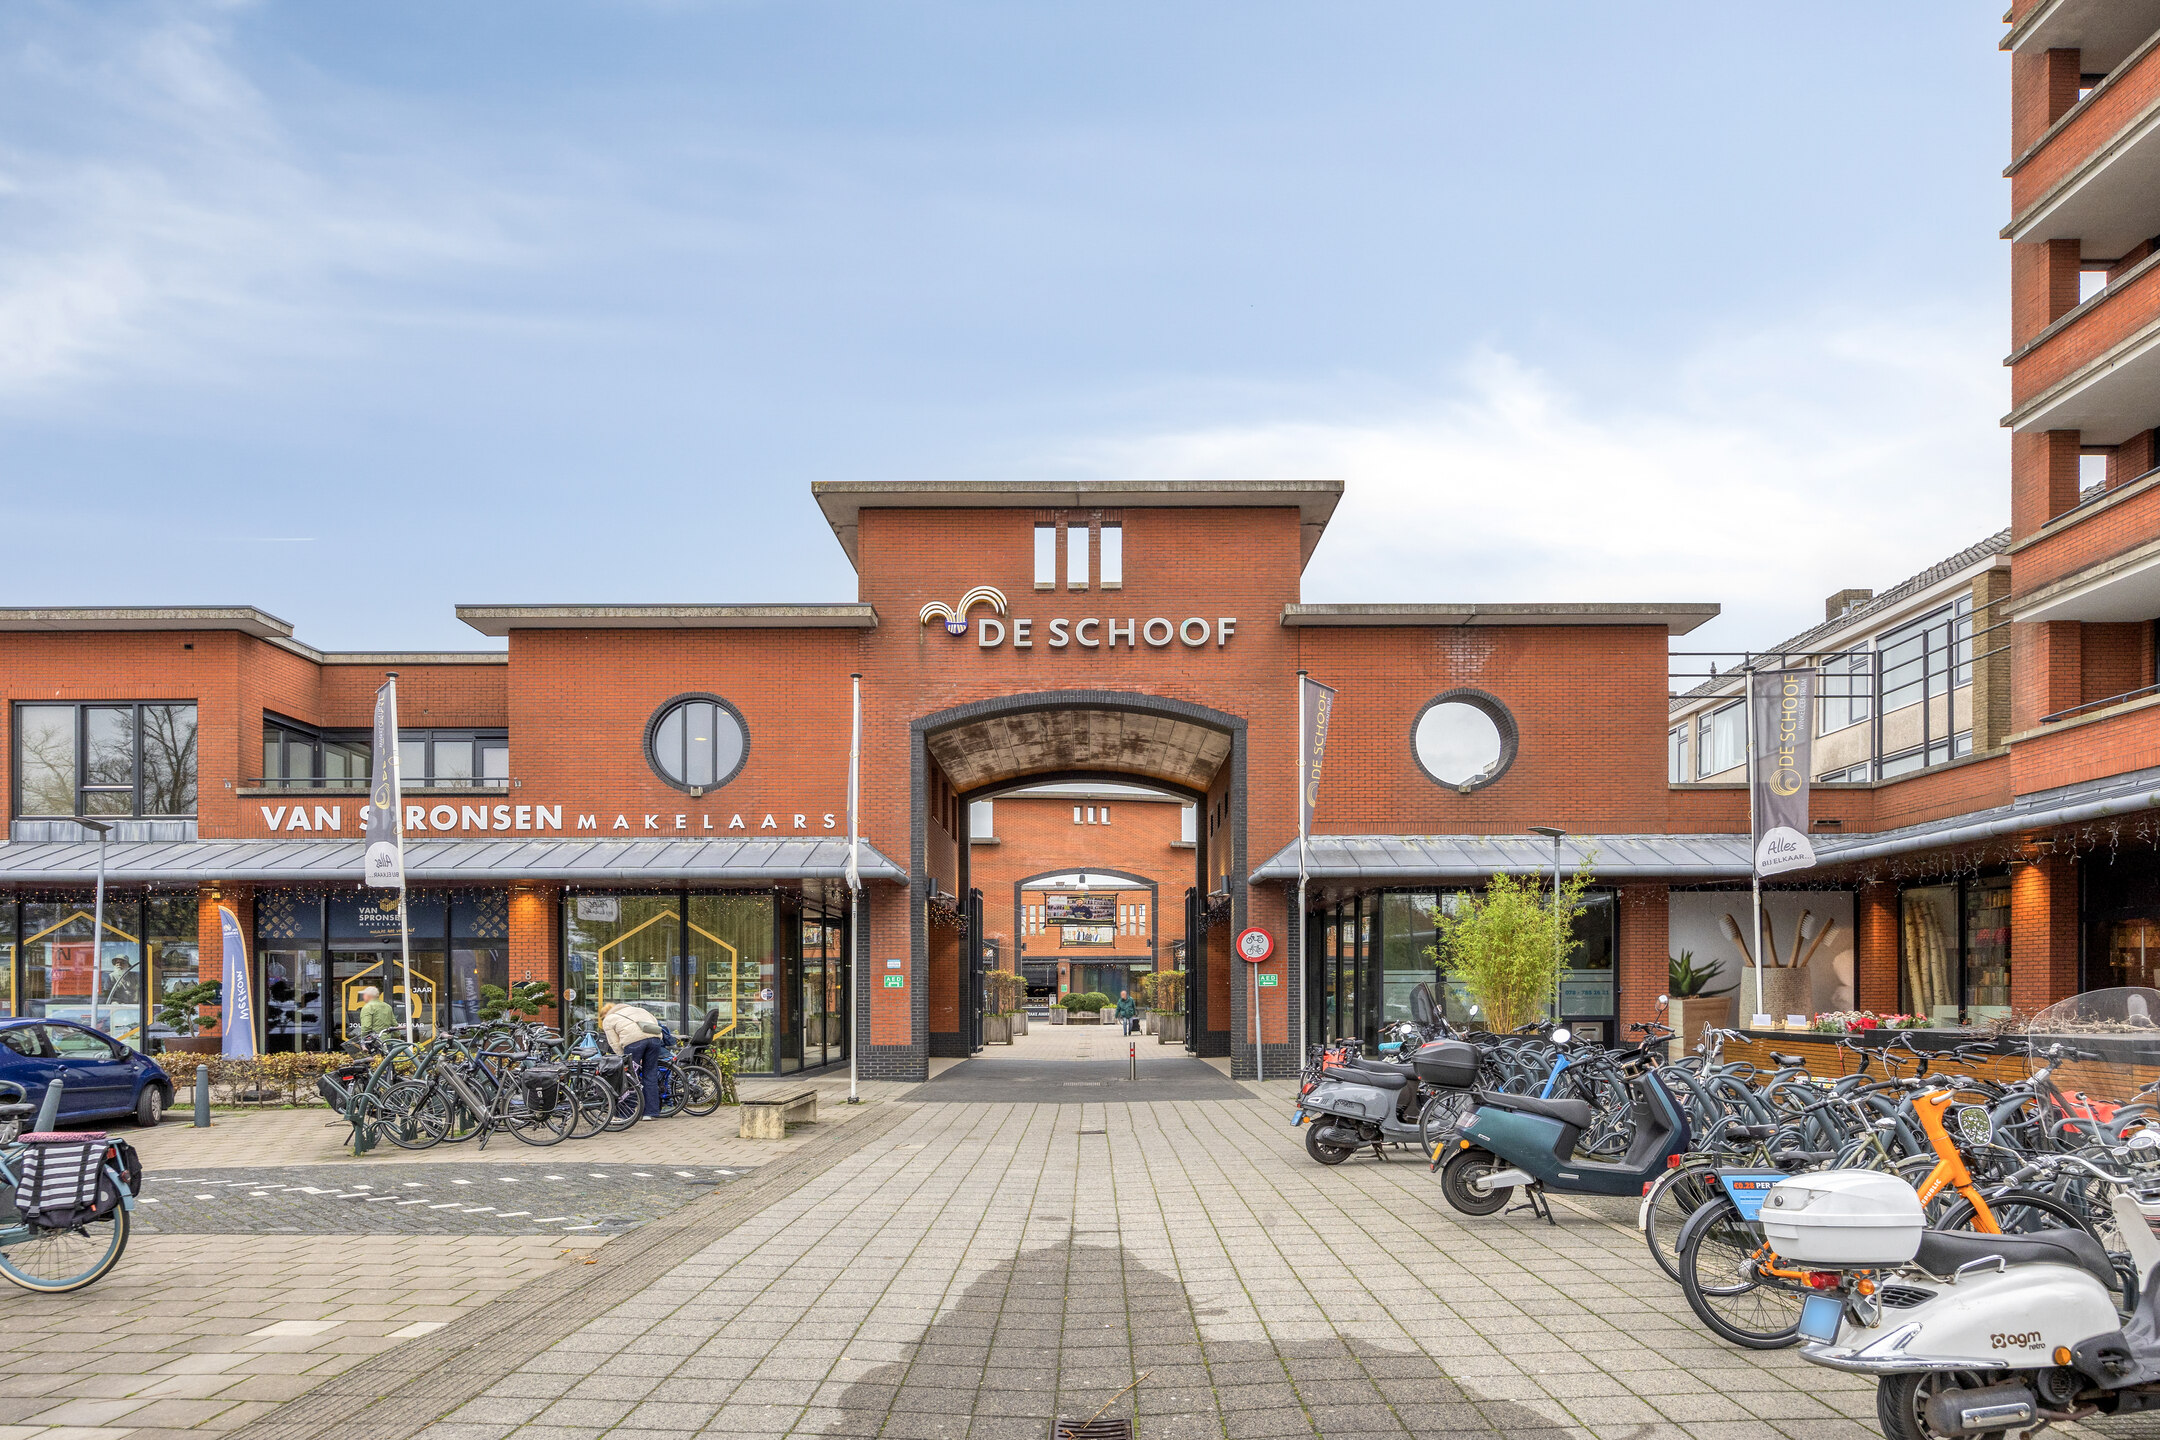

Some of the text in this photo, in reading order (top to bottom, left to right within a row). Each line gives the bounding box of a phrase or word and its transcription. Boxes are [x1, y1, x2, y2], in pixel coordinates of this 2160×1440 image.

[978, 617, 1237, 647] DE SCHOOF
[1797, 678, 1808, 731] WINKELCENTRUM
[1312, 690, 1327, 779] DE SCHOOF
[1779, 674, 1799, 766] DE SCHOOF
[260, 806, 341, 831] VAN
[577, 813, 836, 830] MAKELAARS
[1767, 837, 1797, 856] Alles
[525, 970, 532, 980] 8
[1920, 1178, 1942, 1207] EPUBLIC
[2007, 1331, 2042, 1348] agm
